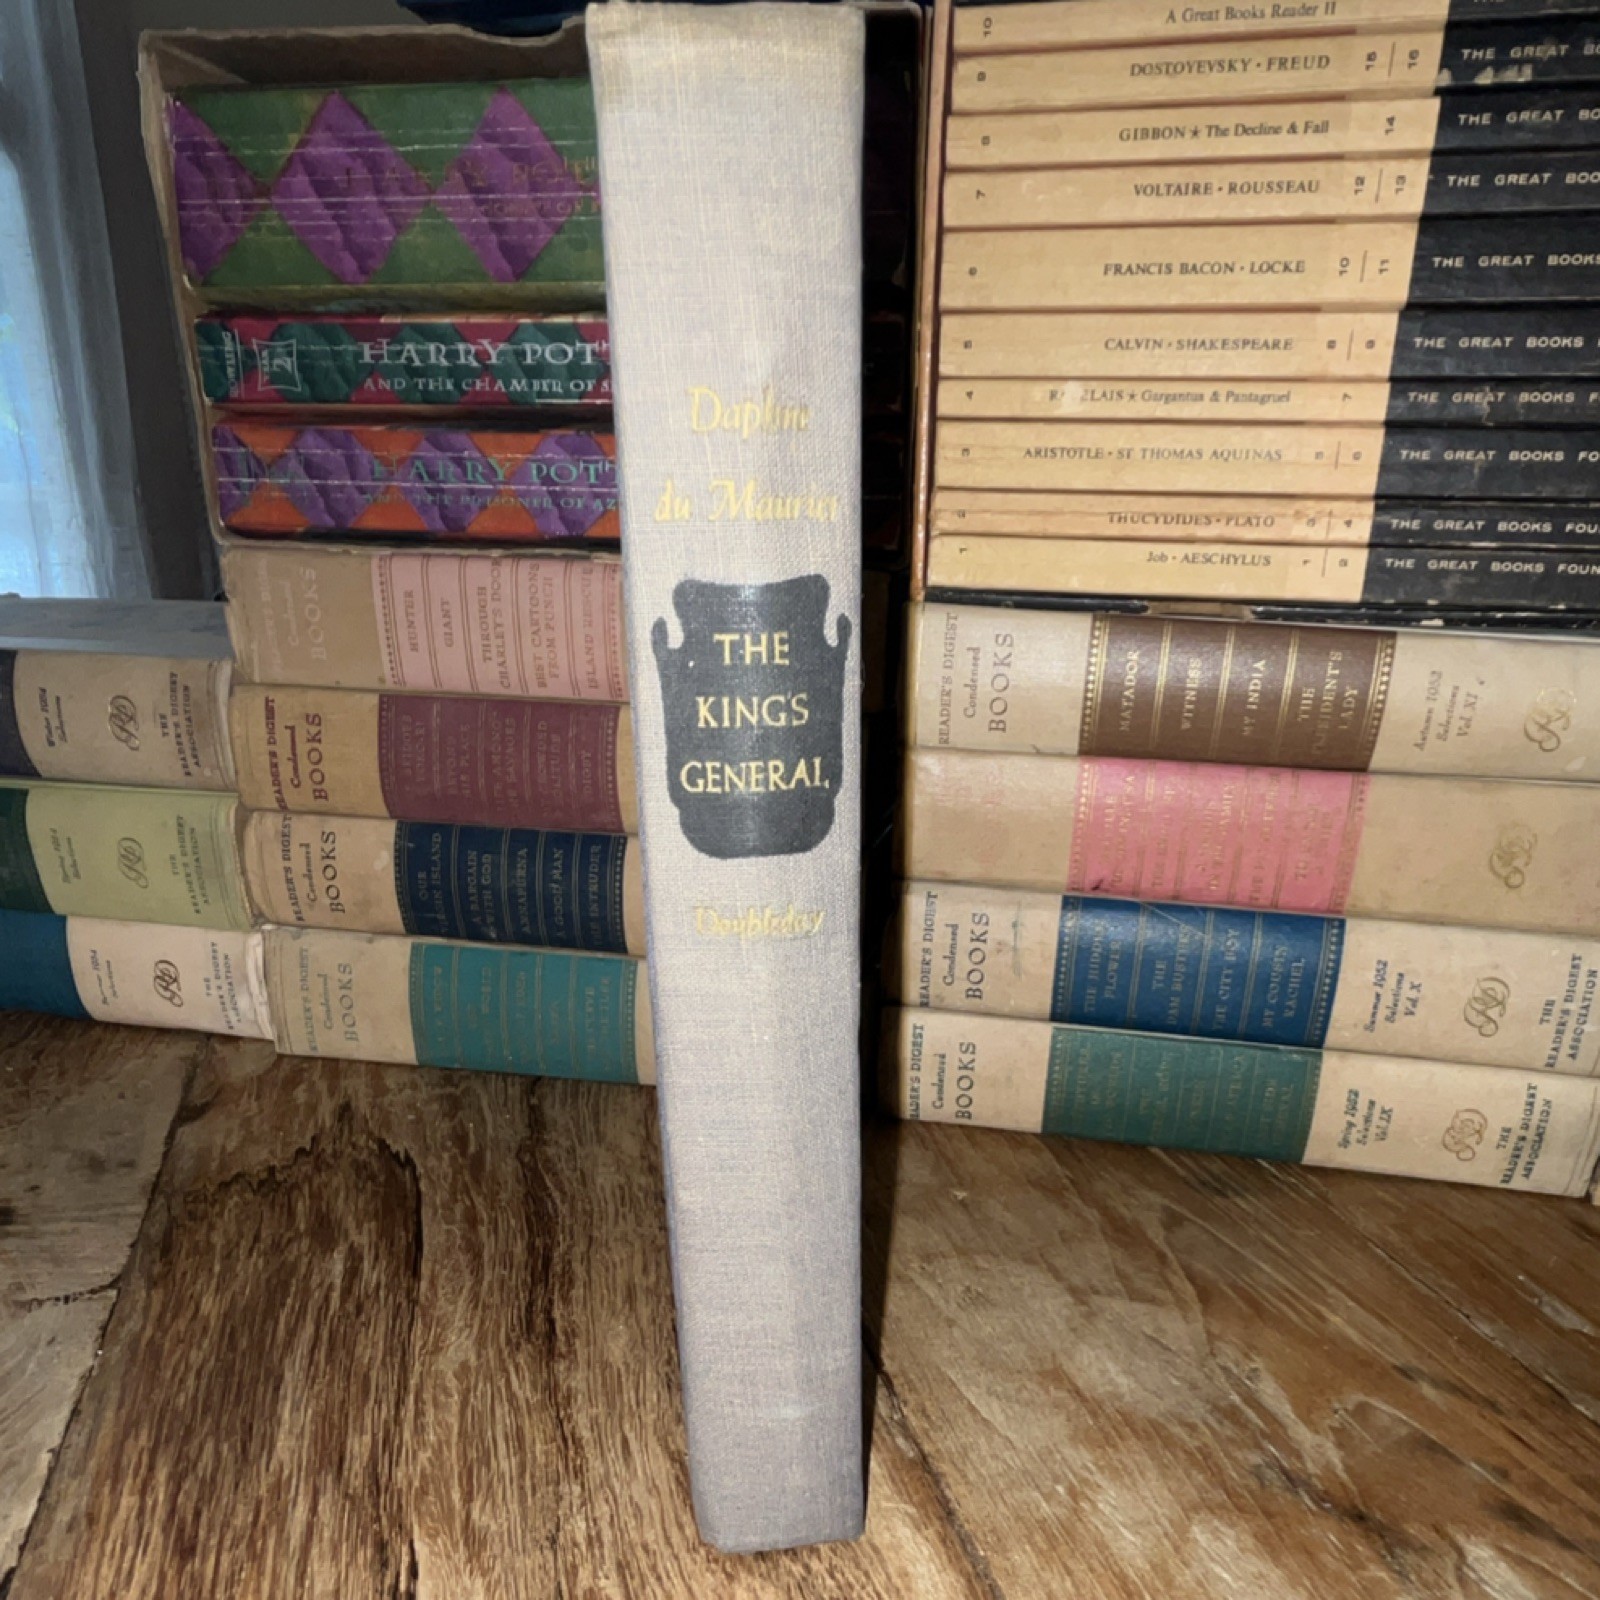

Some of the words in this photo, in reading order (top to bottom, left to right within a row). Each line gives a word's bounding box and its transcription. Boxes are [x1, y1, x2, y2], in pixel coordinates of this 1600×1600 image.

[1165, 9, 1177, 24] A
[1181, 7, 1221, 23] Great
[1224, 4, 1266, 21] Books
[1271, 3, 1318, 18] Reader
[1325, 2, 1337, 15] II
[1129, 58, 1251, 77] DOSTOYEVSKY
[1266, 55, 1331, 72] FREUD
[1461, 46, 1496, 60] THE
[1510, 44, 1569, 60] GREAT
[1119, 126, 1186, 141] GIBBON
[1206, 124, 1230, 138] The
[1233, 122, 1283, 137] Decline
[1287, 122, 1298, 135] &
[1303, 120, 1329, 135] Fall
[1458, 113, 1491, 126] THE
[1506, 110, 1565, 123] GREAT
[1133, 182, 1214, 197] VOLTAIRE
[1227, 180, 1320, 196] ROUSSEAU
[1447, 174, 1480, 187] THE
[1494, 172, 1552, 185] GREAT
[1103, 262, 1172, 276] FRANCIS
[1179, 261, 1236, 275] BACON
[1249, 260, 1305, 275] LOCKE
[1432, 256, 1464, 268] THE
[1478, 254, 1534, 267] GREAT
[357, 338, 508, 367] HARRY
[1104, 338, 1164, 351] CALVIN
[1175, 337, 1293, 351] SHAKESPEARE
[1414, 336, 1446, 348] THE
[1459, 336, 1514, 348] GREAT
[1526, 336, 1585, 348] BOOKS
[363, 378, 406, 391] AND
[414, 377, 454, 391] THE
[461, 377, 564, 393] CHAMBER
[569, 378, 597, 392] OF
[1141, 389, 1205, 404] Gargantua
[1209, 390, 1220, 402] &
[1224, 390, 1291, 405] Pantagruel
[1408, 392, 1439, 403] THE
[1452, 391, 1506, 403] GREAT
[1519, 391, 1575, 403] BOOKS
[372, 456, 513, 484] HARRY
[1023, 447, 1104, 460] ARISTOTLE
[1116, 448, 1133, 460] ST
[1141, 448, 1203, 460] THOMAS
[1209, 448, 1282, 462] AQUINAS
[1400, 450, 1431, 461] THE
[1443, 450, 1496, 461] GREAT
[1508, 450, 1564, 462] BOOKS
[655, 478, 692, 523] du
[1107, 512, 1212, 526] THUCYDIDES
[1225, 514, 1275, 528] PLATO
[1390, 519, 1421, 530] THE
[1433, 520, 1485, 531] GREAT
[1497, 521, 1552, 532] BOOKS
[491, 557, 502, 606] DOOR
[1146, 551, 1168, 563] Job
[1179, 553, 1271, 567] AESCHYLUS
[1384, 559, 1415, 569] THE
[1427, 560, 1479, 571] GREAT
[1490, 561, 1545, 573] BOOKS
[300, 566, 327, 662] BOOKS
[403, 589, 419, 653] HUNTER
[440, 597, 454, 648] GIANT
[477, 585, 493, 664] THROUGH
[527, 562, 543, 649] CARTOONS
[542, 575, 554, 630] PUNCH
[545, 635, 560, 679] FROM
[582, 638, 600, 690] ISLAND
[713, 631, 790, 666] THE
[943, 612, 959, 669] DIGEST
[532, 653, 547, 690] BEST
[963, 646, 981, 719] Condensed
[988, 633, 1014, 734] BOOKS
[1120, 650, 1140, 732] MATADOR
[1181, 657, 1201, 730] WITNESS
[1247, 659, 1266, 710] INDIA
[264, 695, 277, 745] DIGEST
[695, 692, 809, 729] KING'S
[938, 675, 953, 745] READER'S
[1297, 687, 1315, 721] THE
[1338, 685, 1358, 729] LADY
[1435, 685, 1460, 742] Selections
[265, 749, 290, 811] READER'S
[304, 712, 329, 802] BOOKS
[679, 756, 830, 794] GENERAL
[281, 814, 293, 862] DIGEST
[431, 832, 442, 886] ISLAND
[300, 842, 319, 903] Condensed
[320, 830, 346, 914] BOOKS
[417, 870, 429, 901] OUR
[467, 849, 479, 912] BARGAIN
[480, 853, 492, 886] GOD
[551, 847, 564, 881] MAN
[588, 844, 602, 917] INTRUDER
[286, 865, 306, 922] READER'S
[551, 883, 564, 926] GOOD
[923, 891, 938, 943] DIGEST
[919, 948, 932, 1008] READER'S
[942, 923, 959, 987] Condensed
[965, 912, 990, 1001] BOOKS
[1152, 960, 1167, 990] THE
[1267, 946, 1288, 1004] COUSIN
[1373, 959, 1388, 989] 1952
[337, 963, 360, 1042] BOOKS
[1219, 968, 1234, 1000] CITY
[1284, 958, 1305, 1018] RACHEL
[1384, 972, 1405, 1024] Selections
[1539, 999, 1556, 1026] THE
[1544, 1009, 1571, 1068] READER'S
[1563, 953, 1583, 1004] DIGEST
[1565, 968, 1599, 1061] ASSOCIATION
[911, 1023, 925, 1071] DIGEST
[931, 1053, 947, 1110] Condensed
[955, 1042, 976, 1120] BOOKS
[1496, 1126, 1512, 1150] THE
[1501, 1134, 1526, 1184] READER'S
[1520, 1082, 1538, 1132] DIGEST
[1521, 1098, 1553, 1181] ASSOCIATION
